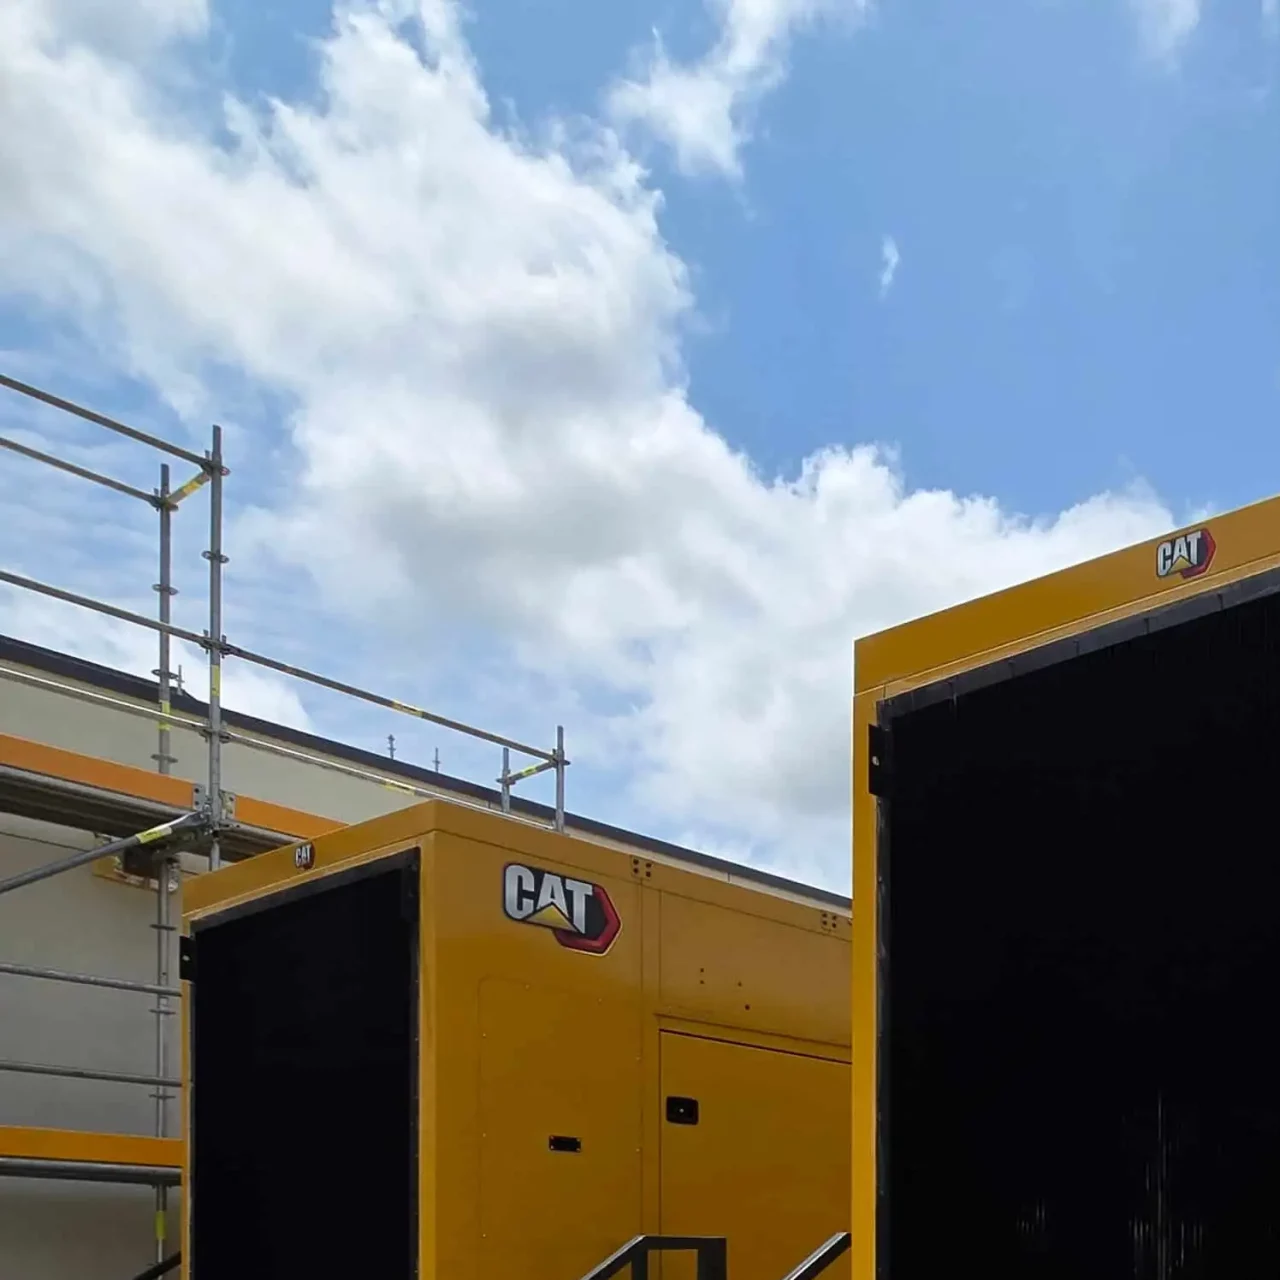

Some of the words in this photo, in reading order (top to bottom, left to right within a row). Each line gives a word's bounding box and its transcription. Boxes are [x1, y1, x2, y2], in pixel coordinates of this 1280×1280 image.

[1157, 530, 1202, 576] CAT
[295, 843, 312, 868] CAT
[505, 864, 593, 934] CAT
